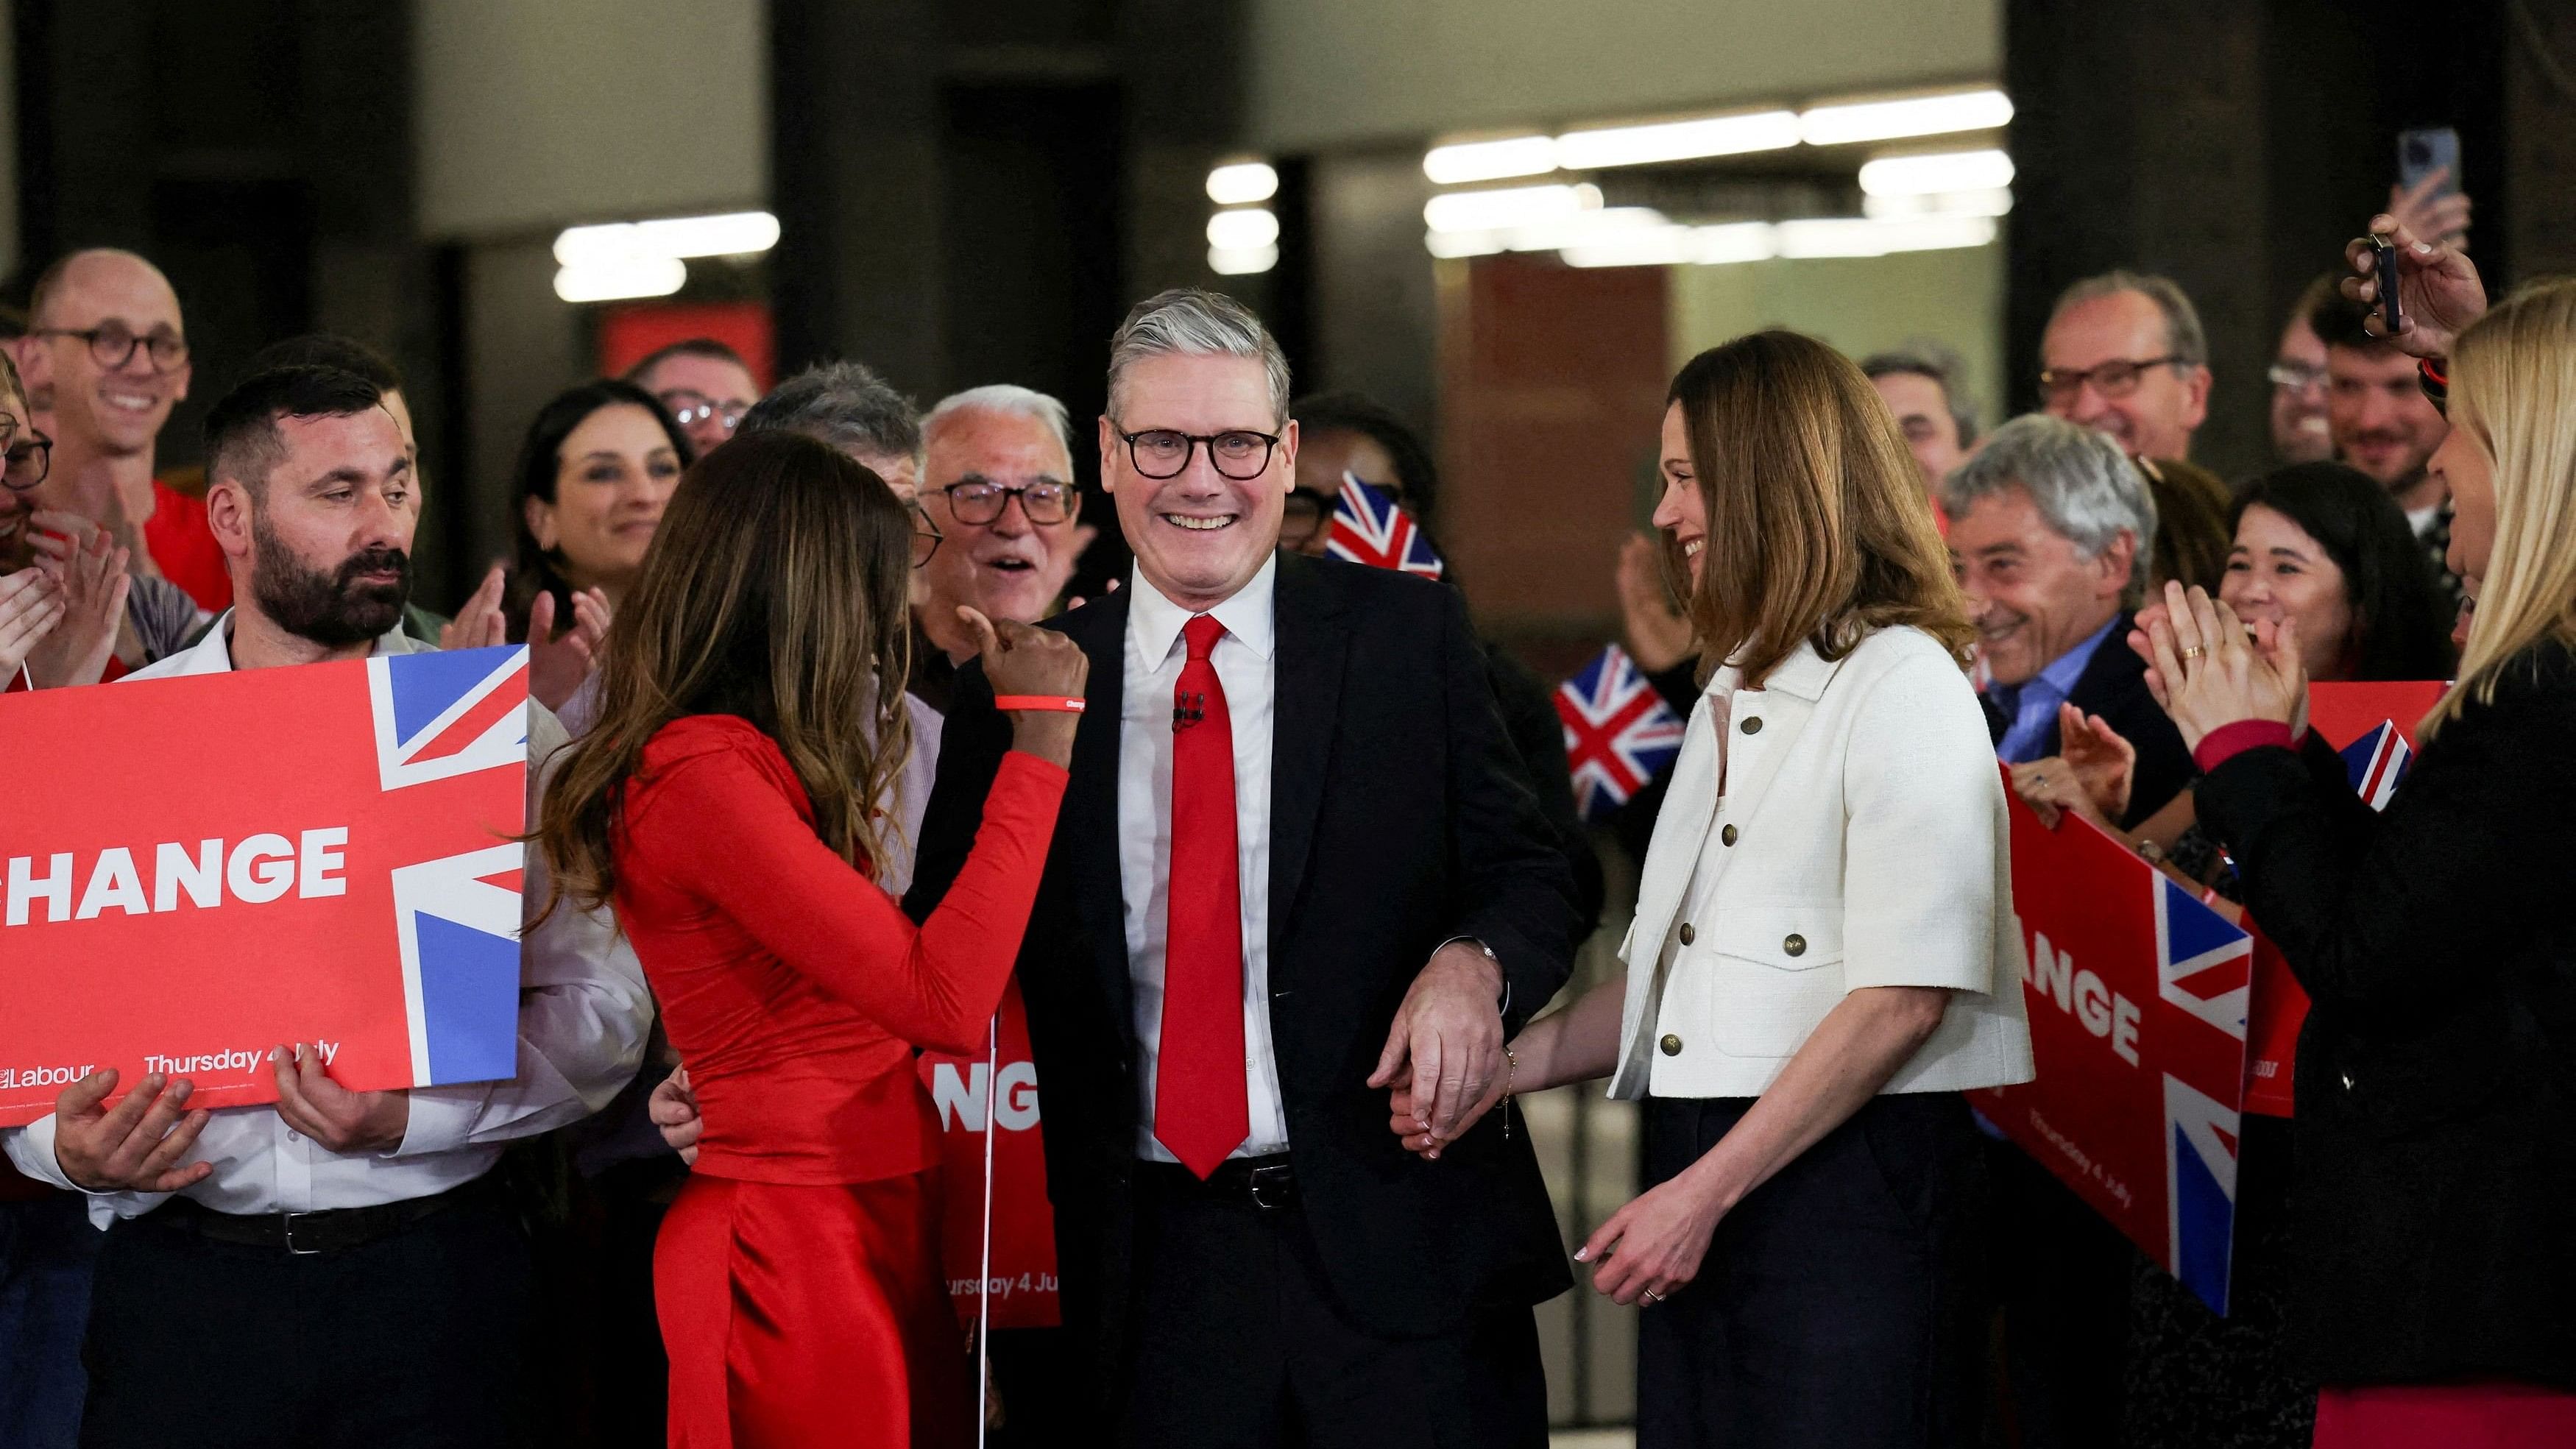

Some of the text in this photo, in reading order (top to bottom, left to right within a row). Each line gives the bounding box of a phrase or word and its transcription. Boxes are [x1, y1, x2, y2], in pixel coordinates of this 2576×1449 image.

[0, 826, 348, 927] HANGE
[144, 1049, 263, 1075] Thursday
[294, 1039, 340, 1066] Jly
[1018, 1272, 1030, 1292] 4
